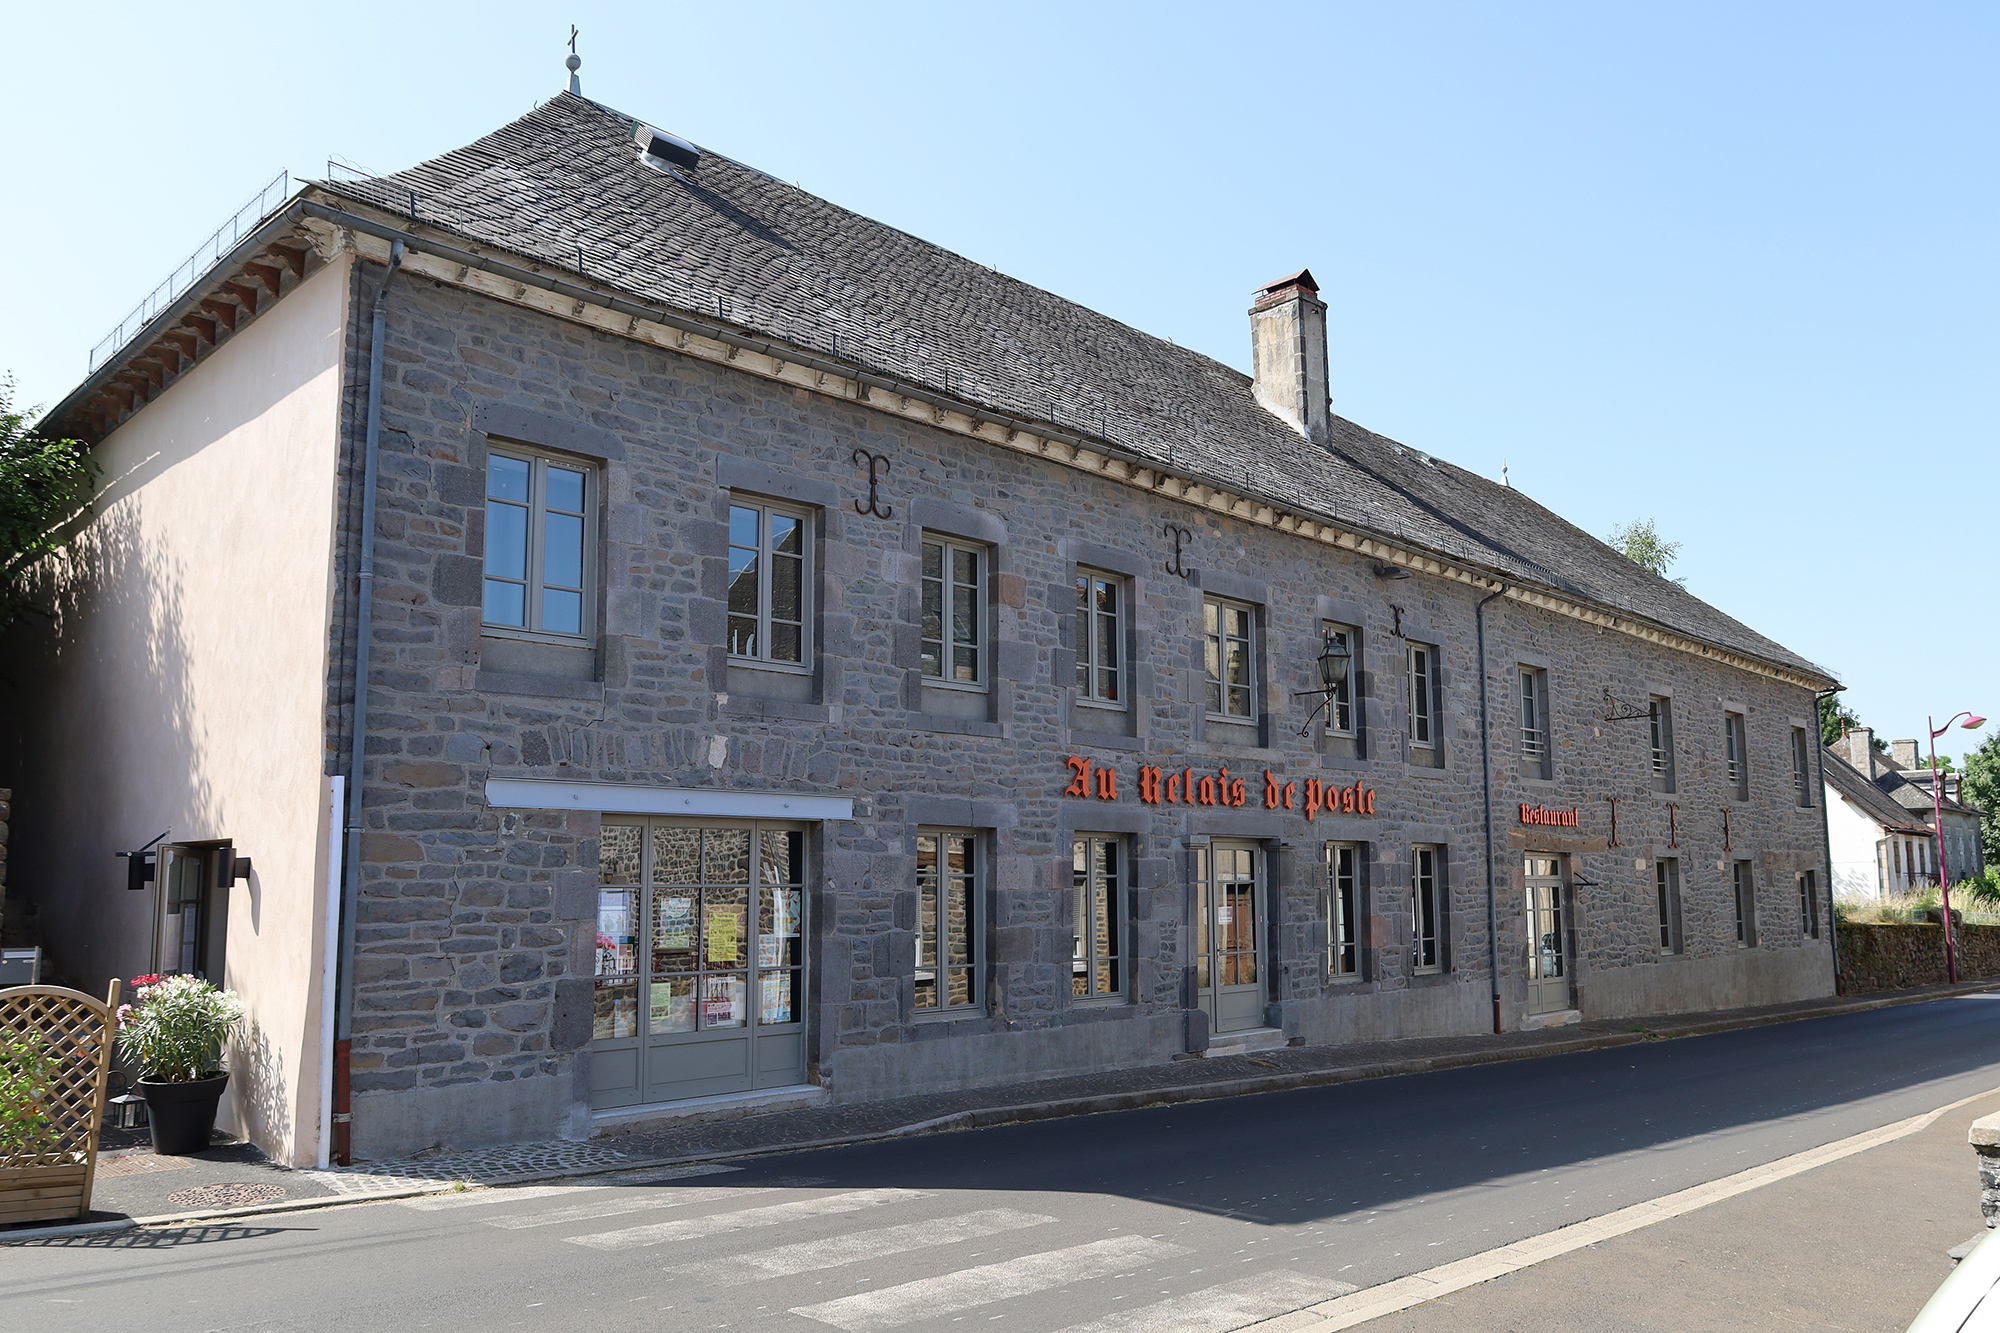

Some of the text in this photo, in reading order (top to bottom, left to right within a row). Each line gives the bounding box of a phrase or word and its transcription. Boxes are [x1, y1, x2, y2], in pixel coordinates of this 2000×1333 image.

[1063, 756, 1118, 801] Au
[1139, 765, 1247, 807] Relais
[1264, 769, 1296, 810] de
[1519, 803, 1579, 827] Restaurant
